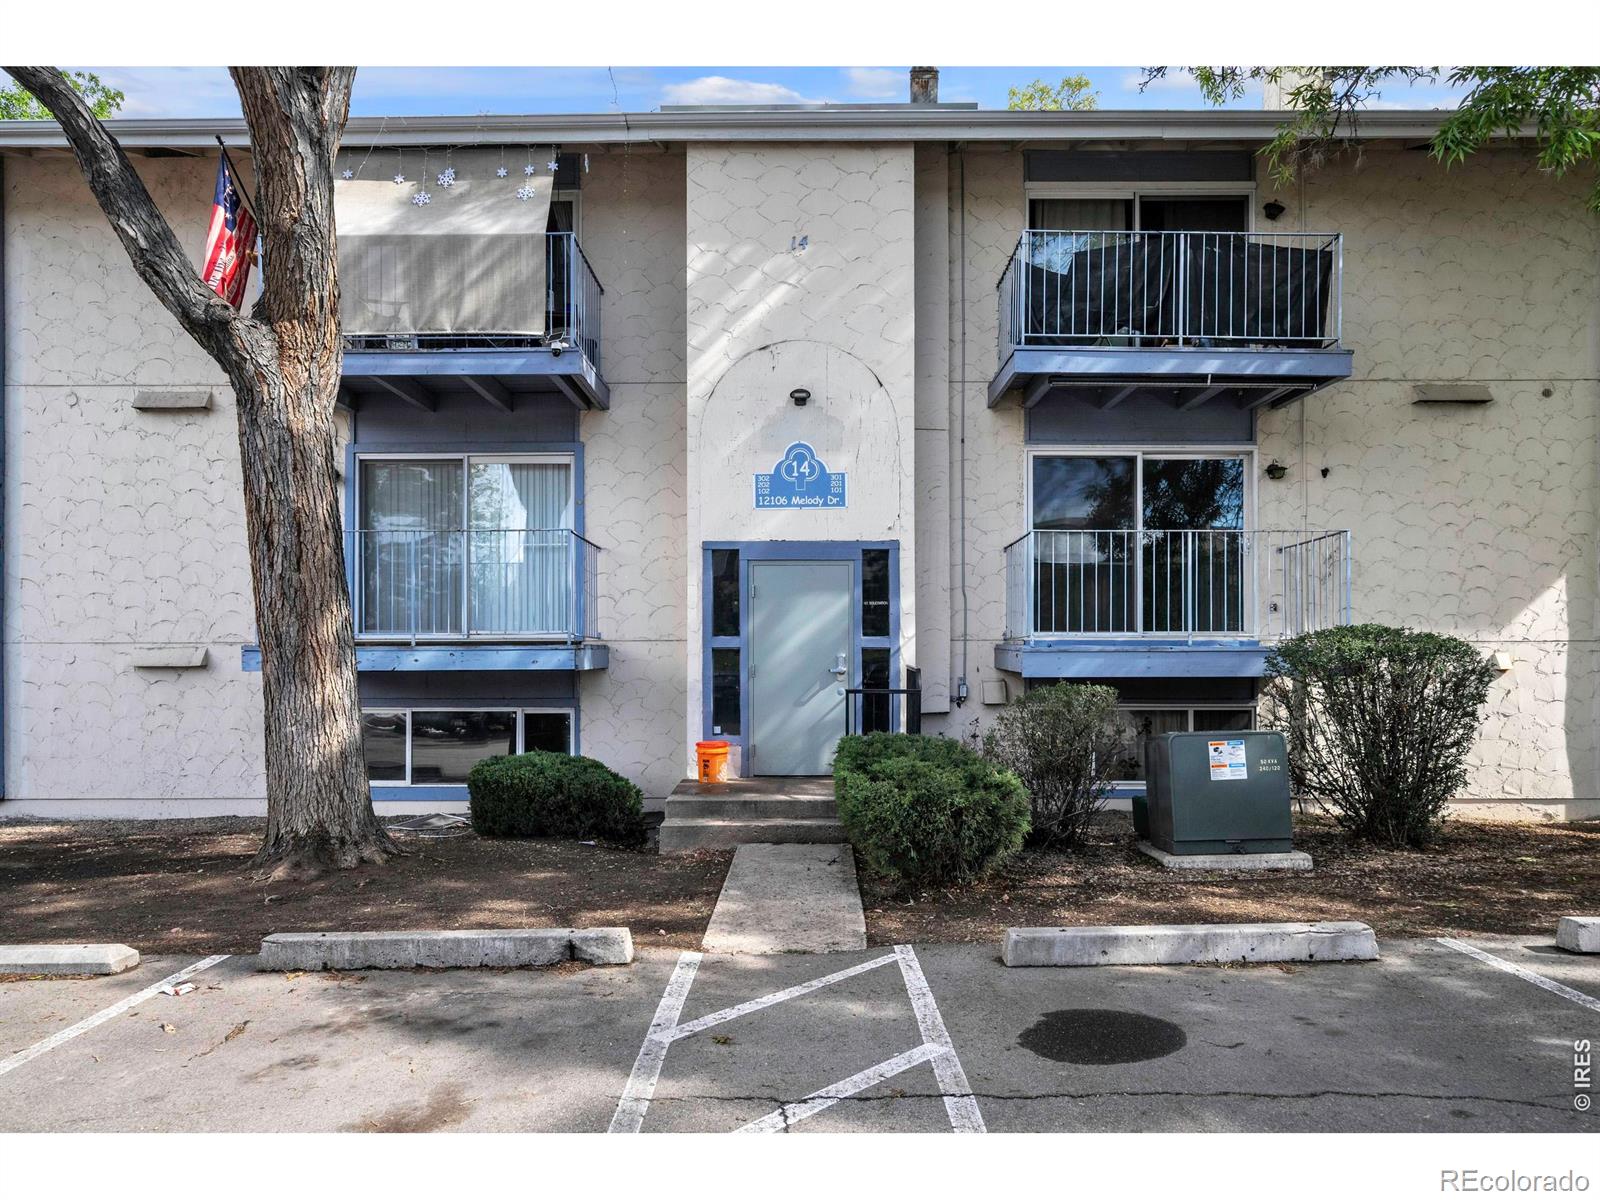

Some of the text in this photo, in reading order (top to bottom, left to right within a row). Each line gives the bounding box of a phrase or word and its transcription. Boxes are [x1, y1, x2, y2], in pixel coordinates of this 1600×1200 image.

[791, 460, 810, 476] 14
[758, 495, 843, 507] 12106 Melody Dr.
